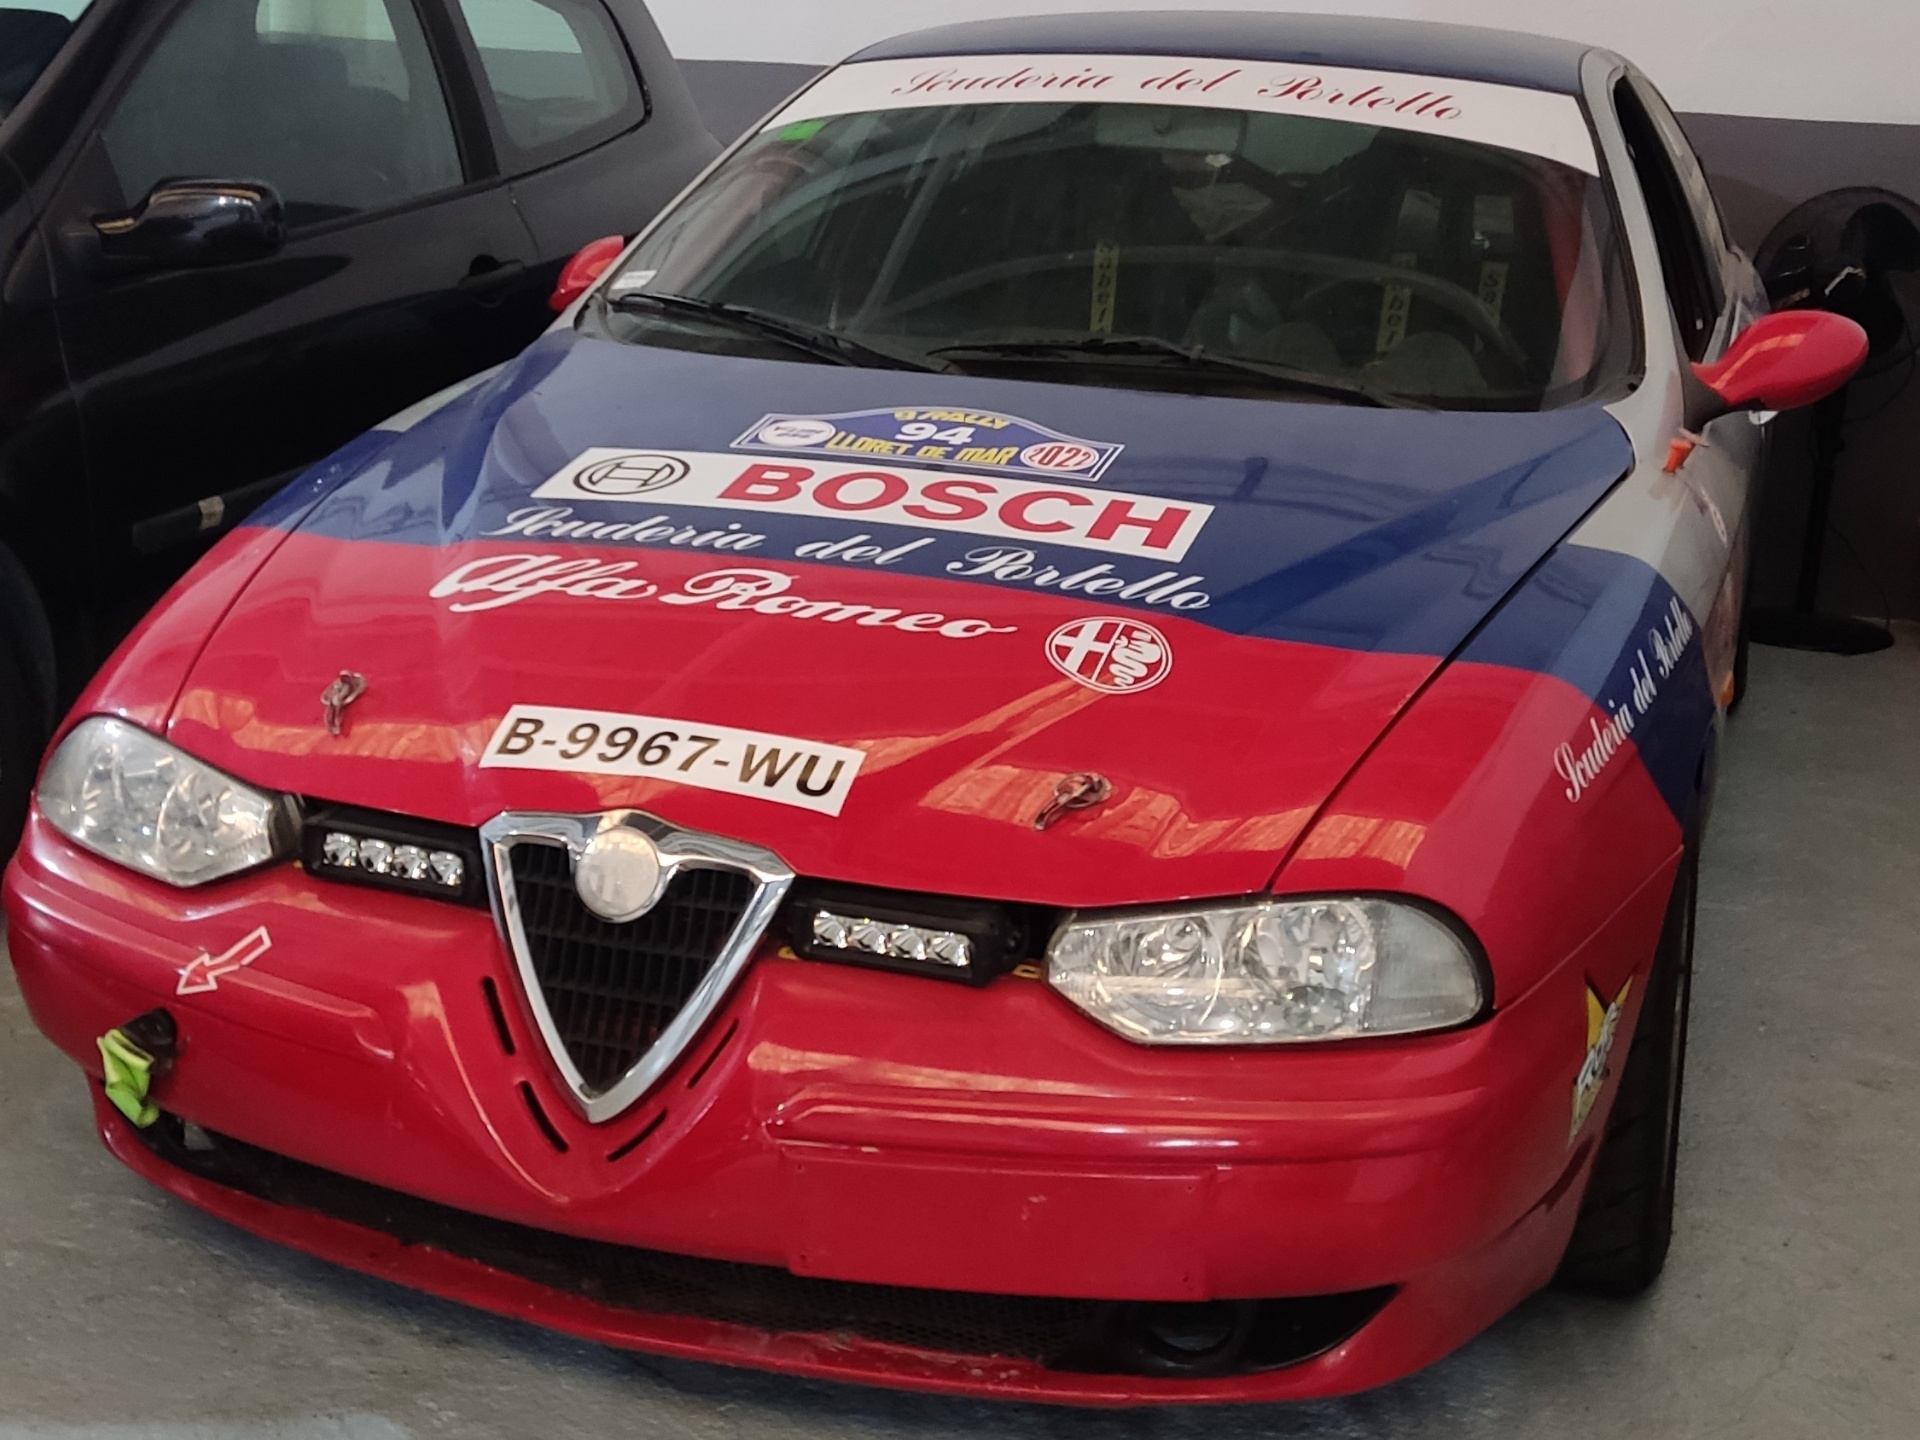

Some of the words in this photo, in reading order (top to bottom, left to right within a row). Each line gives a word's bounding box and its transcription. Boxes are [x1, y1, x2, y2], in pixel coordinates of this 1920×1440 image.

[891, 67, 1114, 95] Scuderia
[1139, 69, 1242, 93] del
[1257, 74, 1463, 120] Portello
[824, 431, 914, 455] LLORET
[916, 445, 953, 460] DE
[955, 446, 1020, 465] MAR
[895, 422, 976, 445] 94
[1028, 445, 1092, 468] 2022
[717, 462, 1192, 550] BOSCH
[429, 553, 659, 614] Alfa
[659, 568, 1017, 639] Romeo
[480, 506, 767, 552] Scuderia
[794, 534, 936, 566] del
[945, 545, 1212, 611] Portello
[495, 717, 846, 797] B-9967-WU
[1554, 699, 1635, 803] Scuderia
[1630, 649, 1657, 715] del
